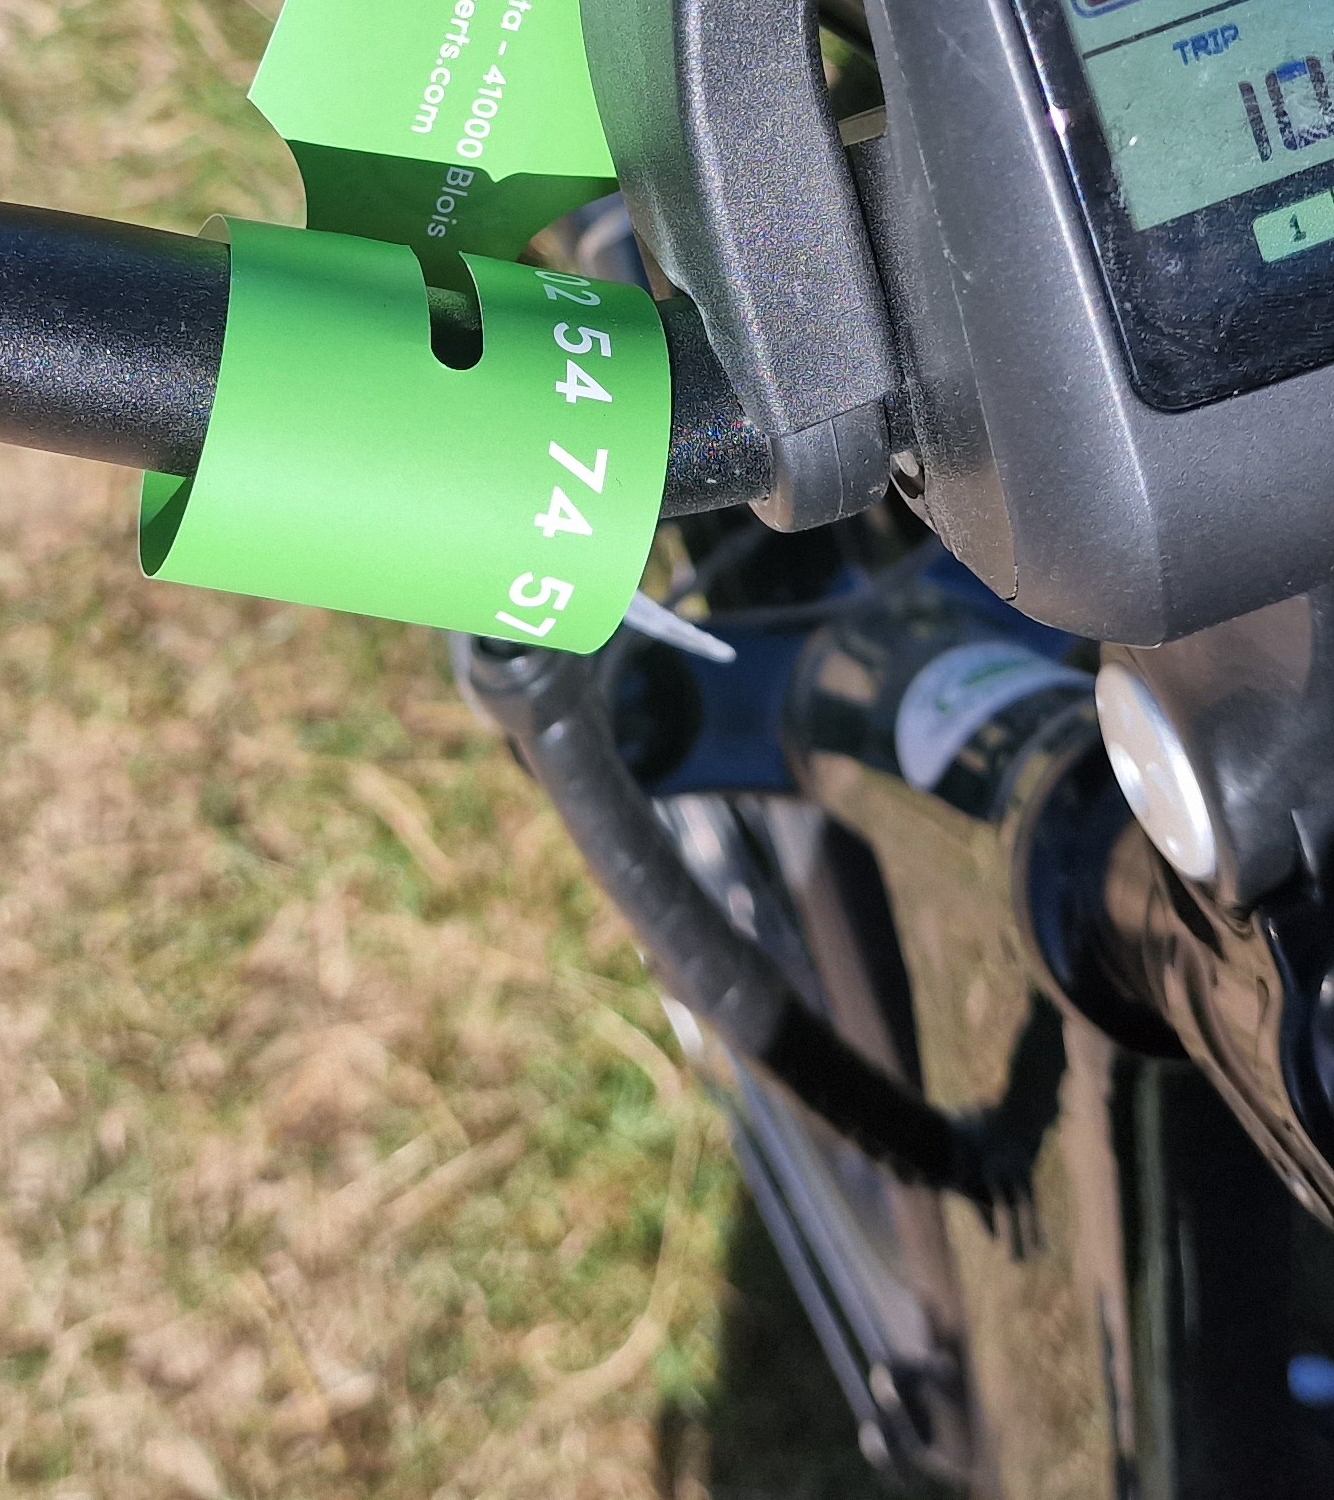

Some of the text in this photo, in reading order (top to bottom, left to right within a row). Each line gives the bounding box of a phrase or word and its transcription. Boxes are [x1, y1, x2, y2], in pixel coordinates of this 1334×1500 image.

[1172, 23, 1241, 67] TRIP
[456, 64, 507, 160] 41000
[427, 165, 475, 239] Blois
[1287, 212, 1307, 243] 1
[534, 269, 602, 308] 02
[553, 321, 613, 405] 54
[533, 440, 609, 539] 74
